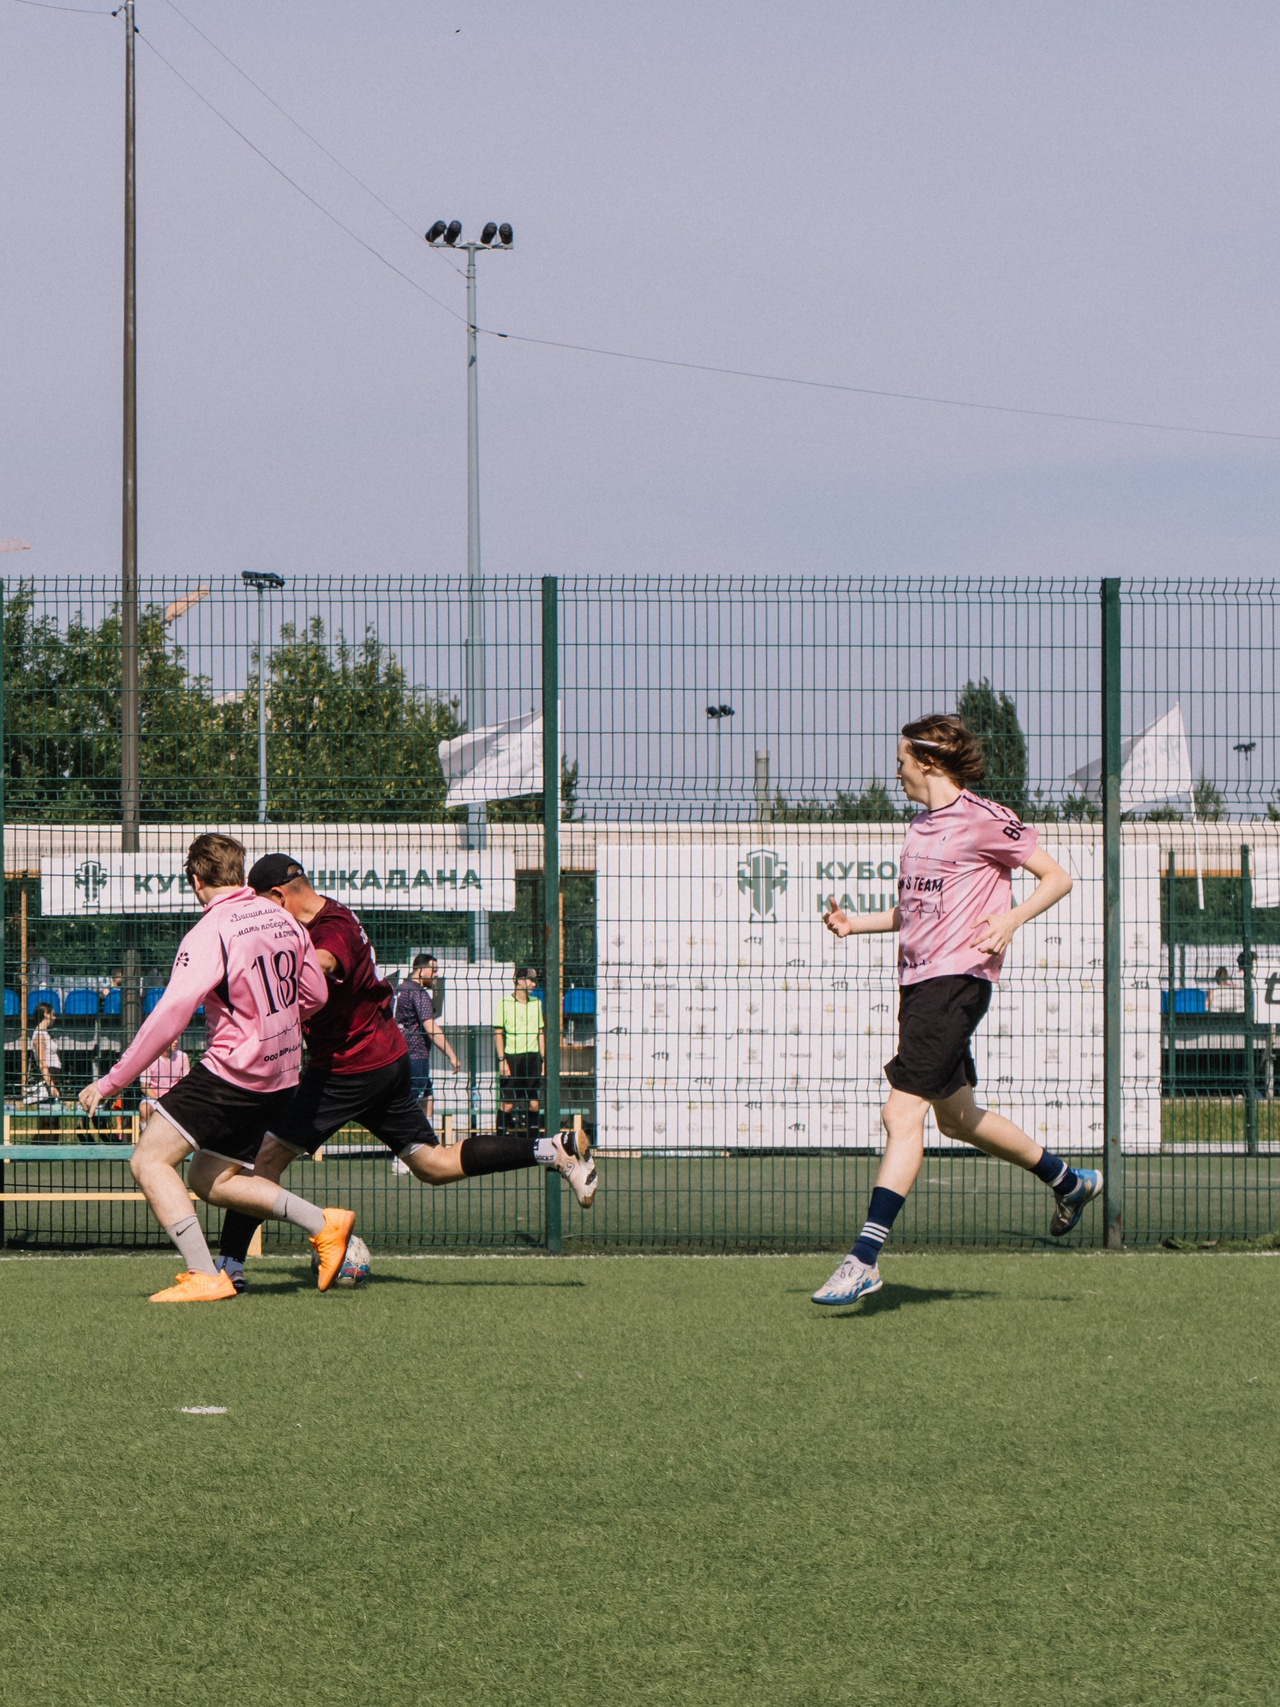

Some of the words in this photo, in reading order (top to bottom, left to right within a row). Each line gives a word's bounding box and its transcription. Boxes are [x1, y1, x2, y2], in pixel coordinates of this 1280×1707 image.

[307, 869, 483, 894] ШКАДАНА
[816, 861, 898, 880] КУБО
[913, 876, 944, 892] TEAM
[251, 949, 297, 1017] 18
